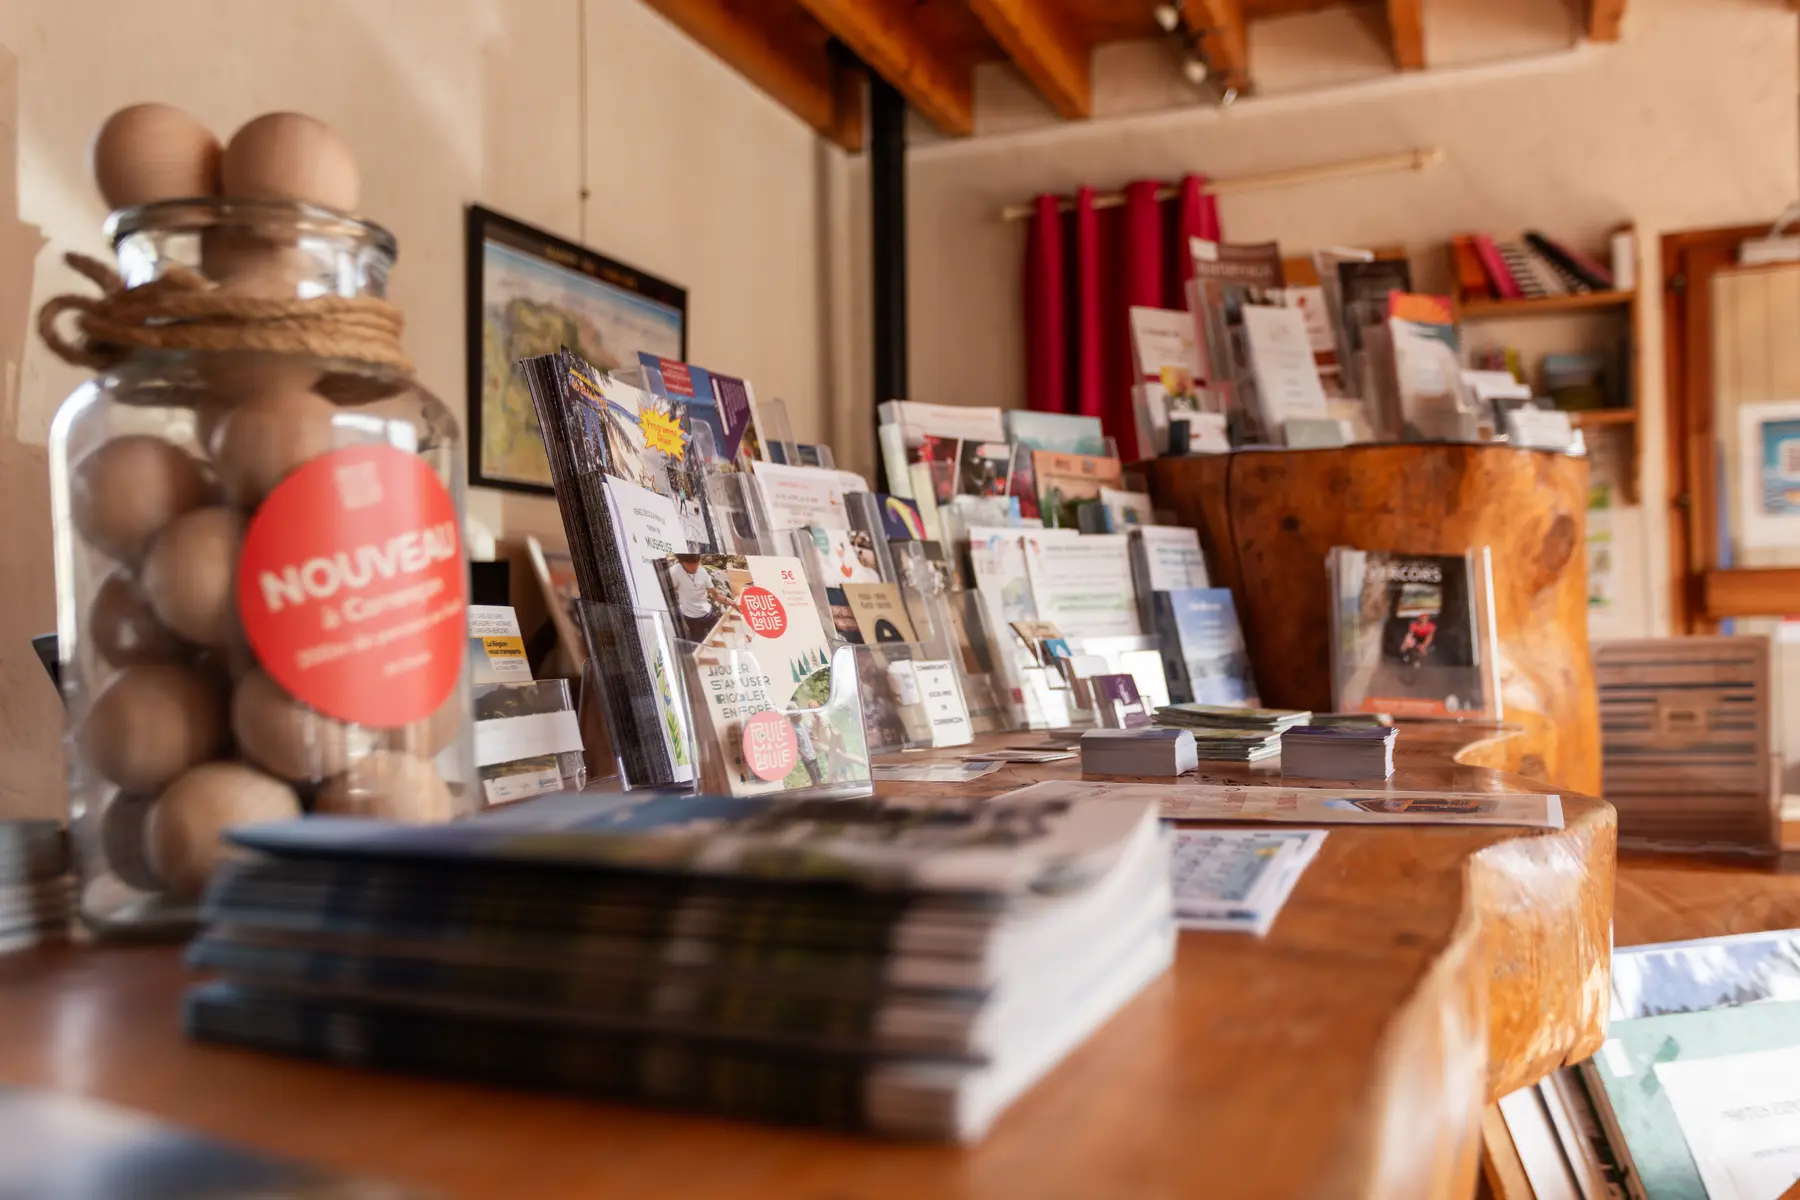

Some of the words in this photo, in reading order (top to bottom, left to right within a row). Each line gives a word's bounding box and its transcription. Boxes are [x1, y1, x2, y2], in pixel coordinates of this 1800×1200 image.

[258, 521, 456, 614] NOUVEAU
[781, 570, 795, 580] 5€
[722, 707, 738, 719] EN
